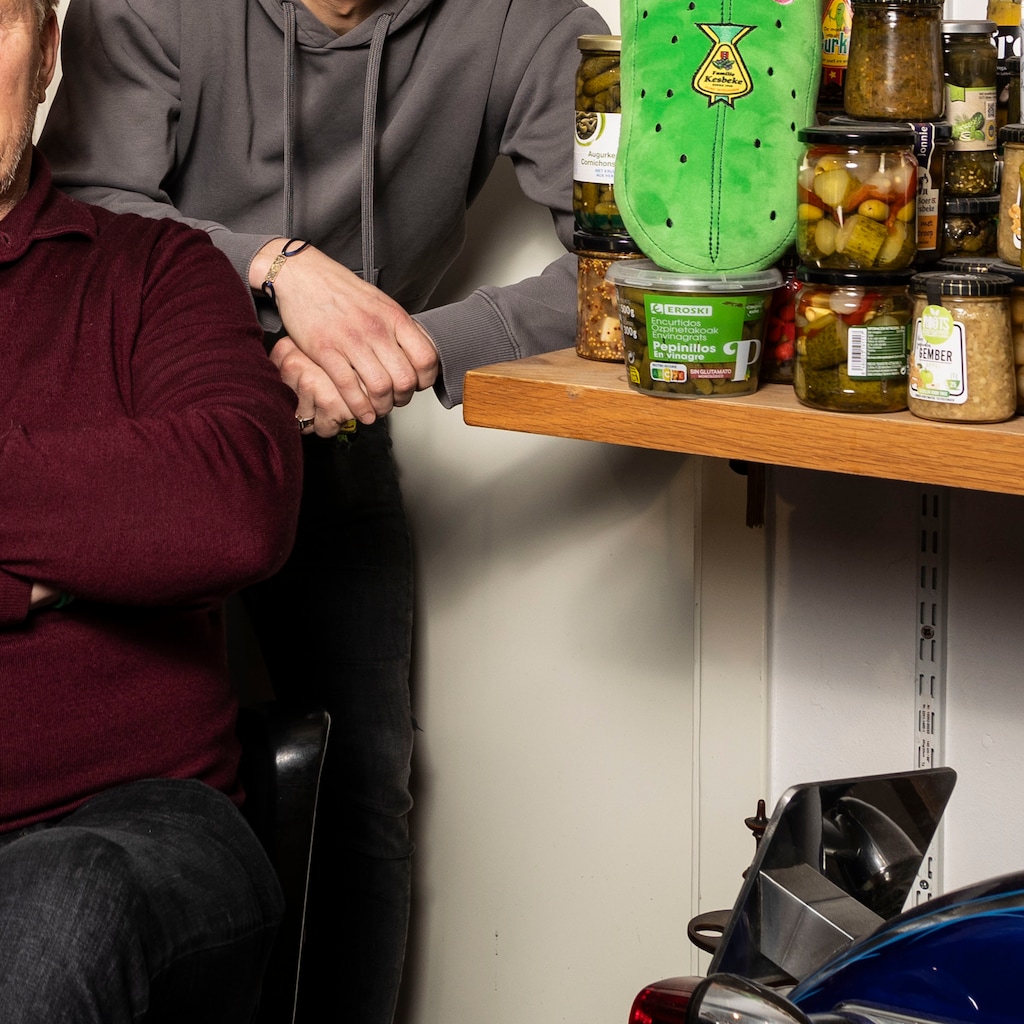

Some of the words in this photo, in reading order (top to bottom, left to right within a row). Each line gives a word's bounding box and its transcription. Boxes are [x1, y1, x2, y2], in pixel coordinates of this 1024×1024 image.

[704, 75, 743, 85] Kesbeke
[588, 150, 616, 160] Augurke
[668, 307, 709, 315] EROSKI
[651, 317, 701, 327] Encurtidos
[651, 324, 719, 335] Ozpinetakoak
[652, 332, 707, 342] Envinagrats
[653, 341, 716, 354] Pepinillos
[654, 351, 664, 359] En
[666, 352, 705, 362] vinagre
[919, 347, 953, 362] GEMBER
